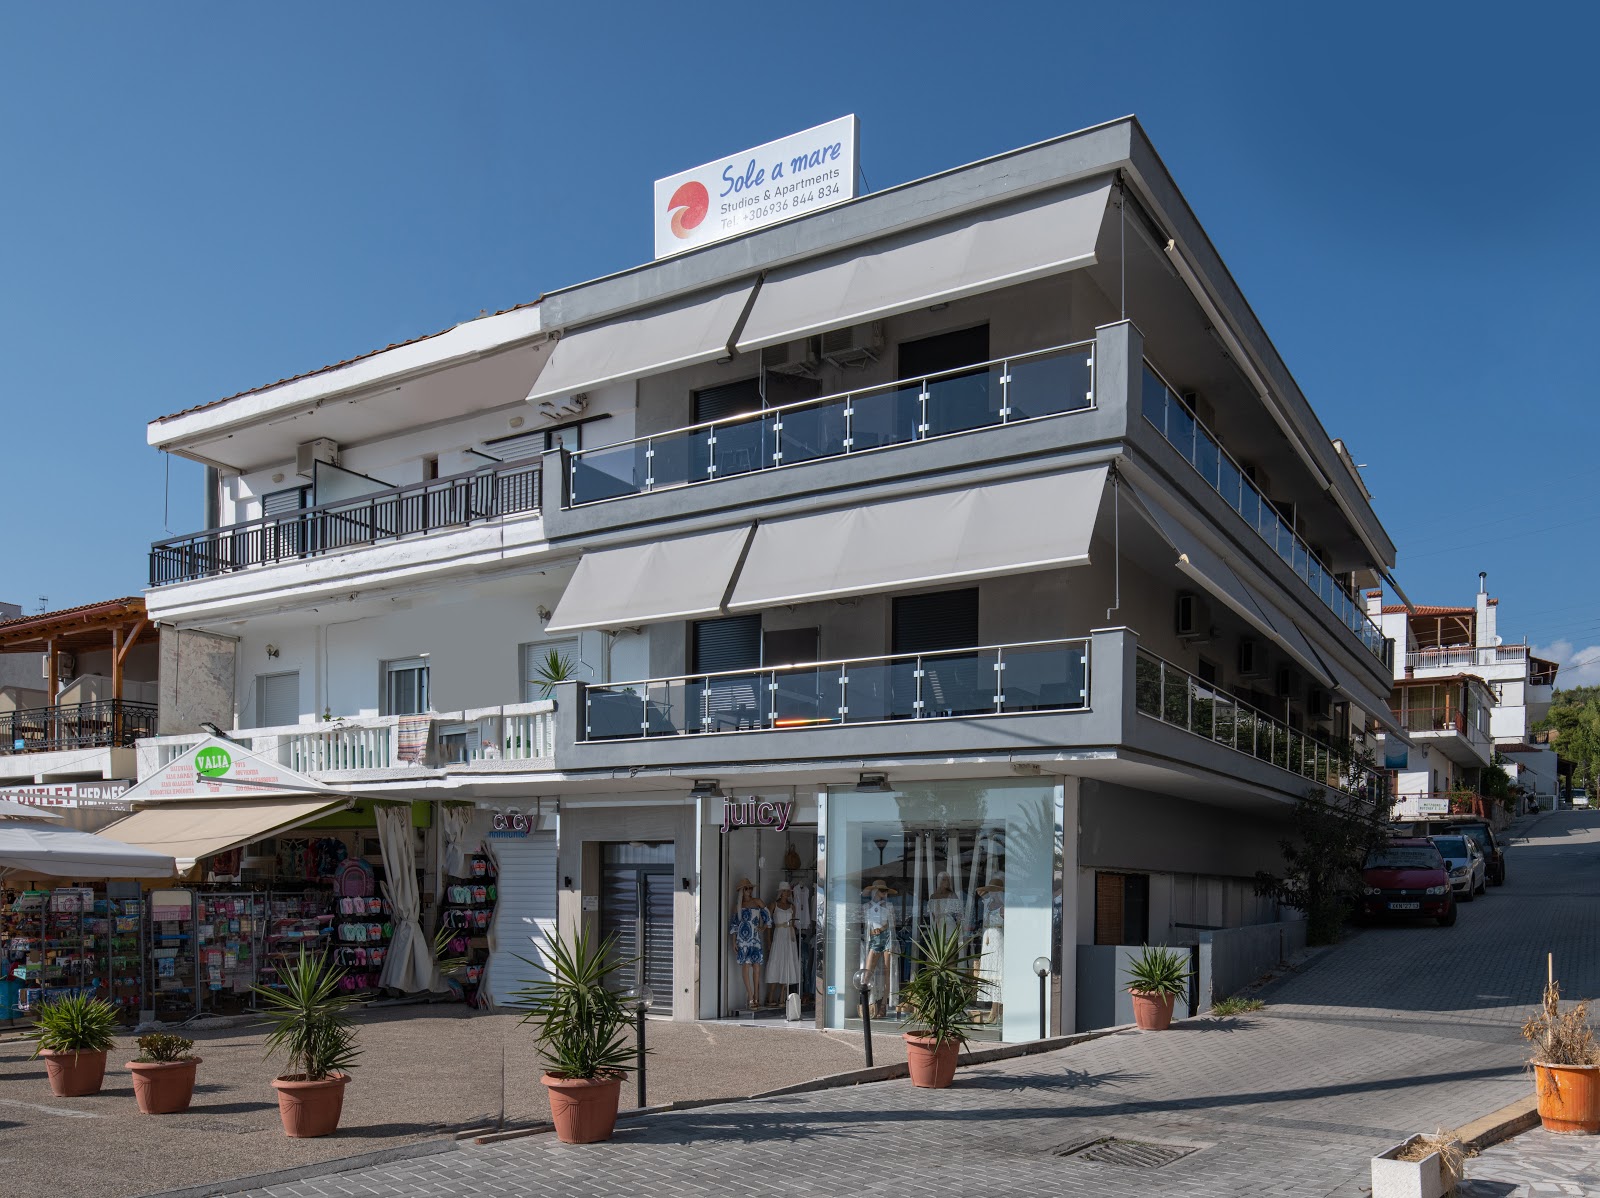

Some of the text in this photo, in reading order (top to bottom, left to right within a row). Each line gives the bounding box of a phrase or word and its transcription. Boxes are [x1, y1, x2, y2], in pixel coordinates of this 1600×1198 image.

[720, 142, 842, 198] Sole a mare
[720, 168, 840, 215] Studios & Apartments
[742, 198, 789, 222] +306936
[792, 191, 814, 207] 844
[818, 183, 840, 200] 834
[197, 755, 229, 769] VALIA
[17, 786, 73, 807] OUTLET
[720, 796, 792, 833] juicy
